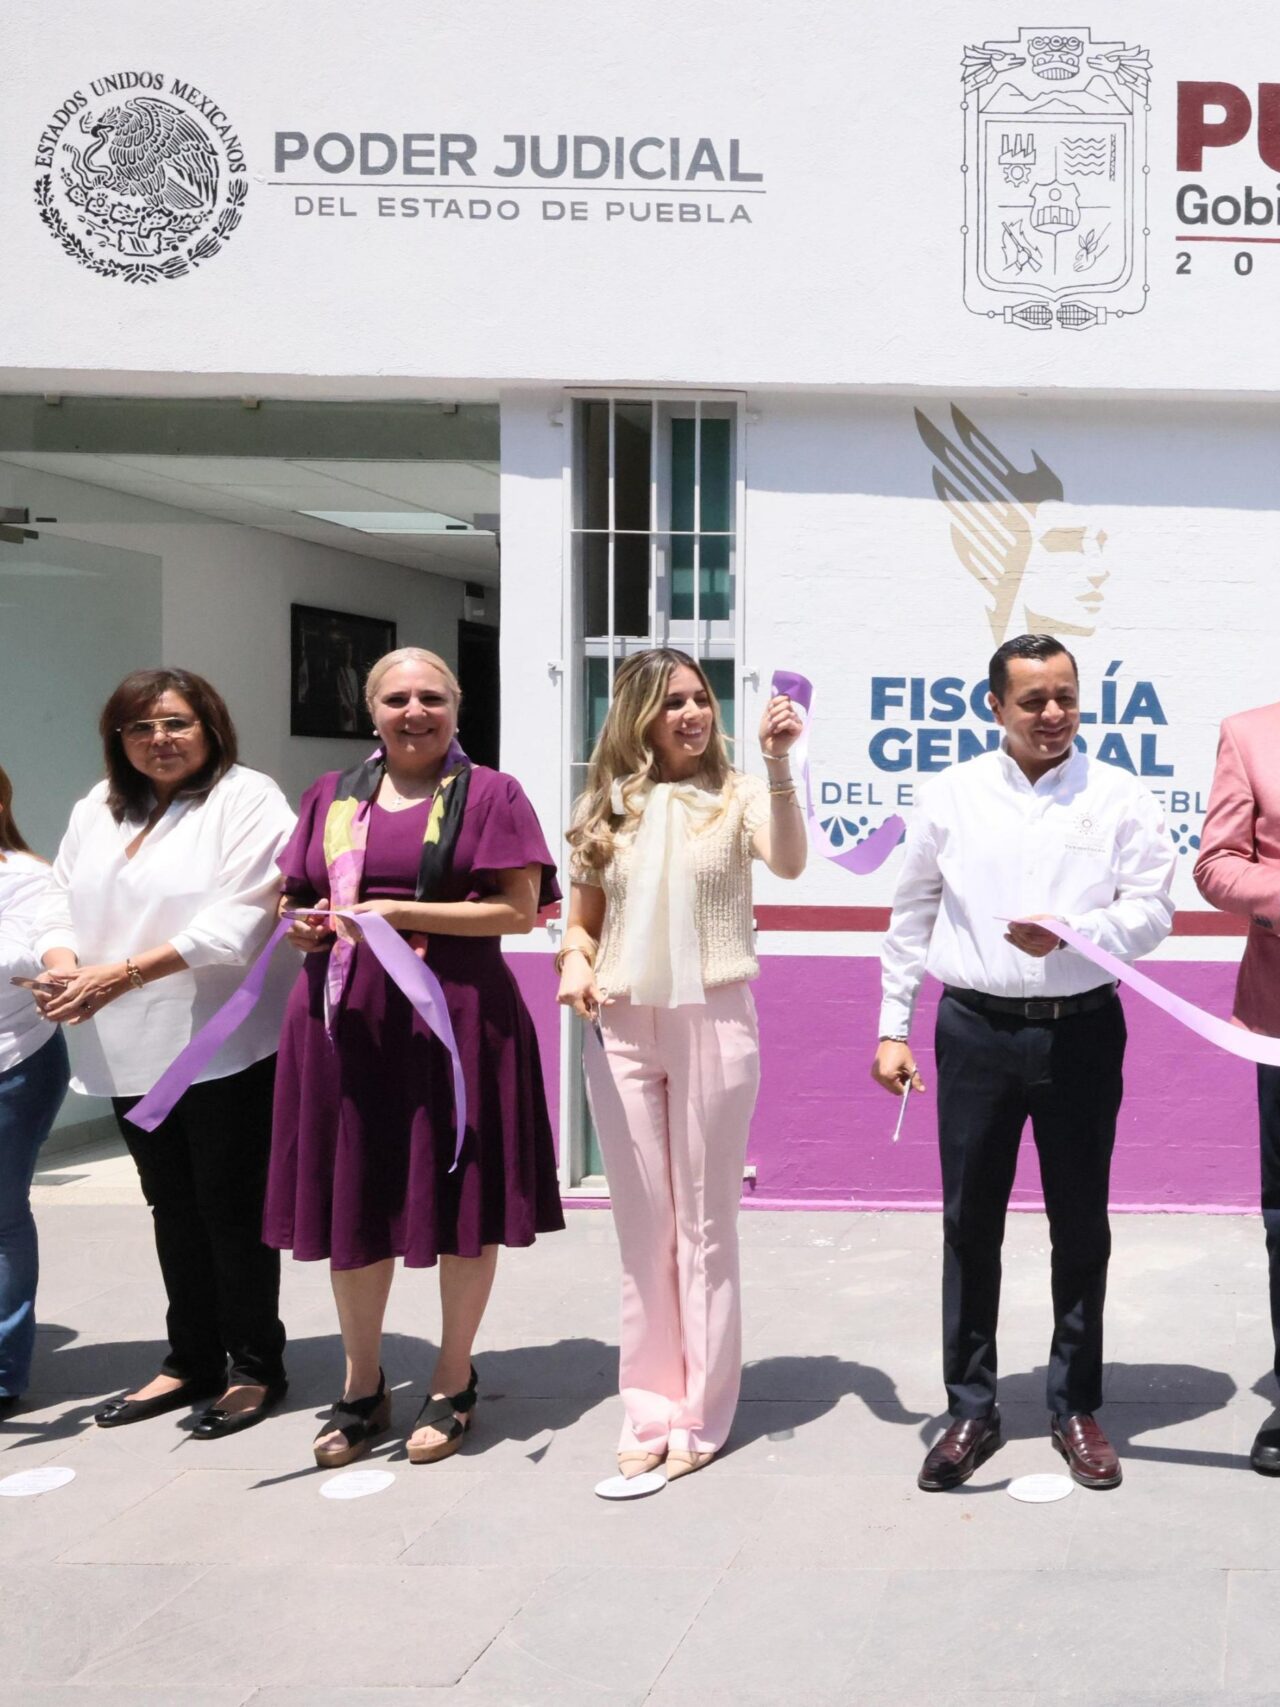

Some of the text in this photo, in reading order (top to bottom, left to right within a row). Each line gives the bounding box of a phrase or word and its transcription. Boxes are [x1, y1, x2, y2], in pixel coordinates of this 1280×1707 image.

[35, 71, 246, 173] ESTADOS UNIDOS MEXICANOS
[275, 132, 764, 182] PODER JUDICIAL
[295, 197, 752, 223] DEL ESTADO DE PUEBLA
[868, 727, 1174, 777] GENAL
[822, 782, 882, 805] DEL
